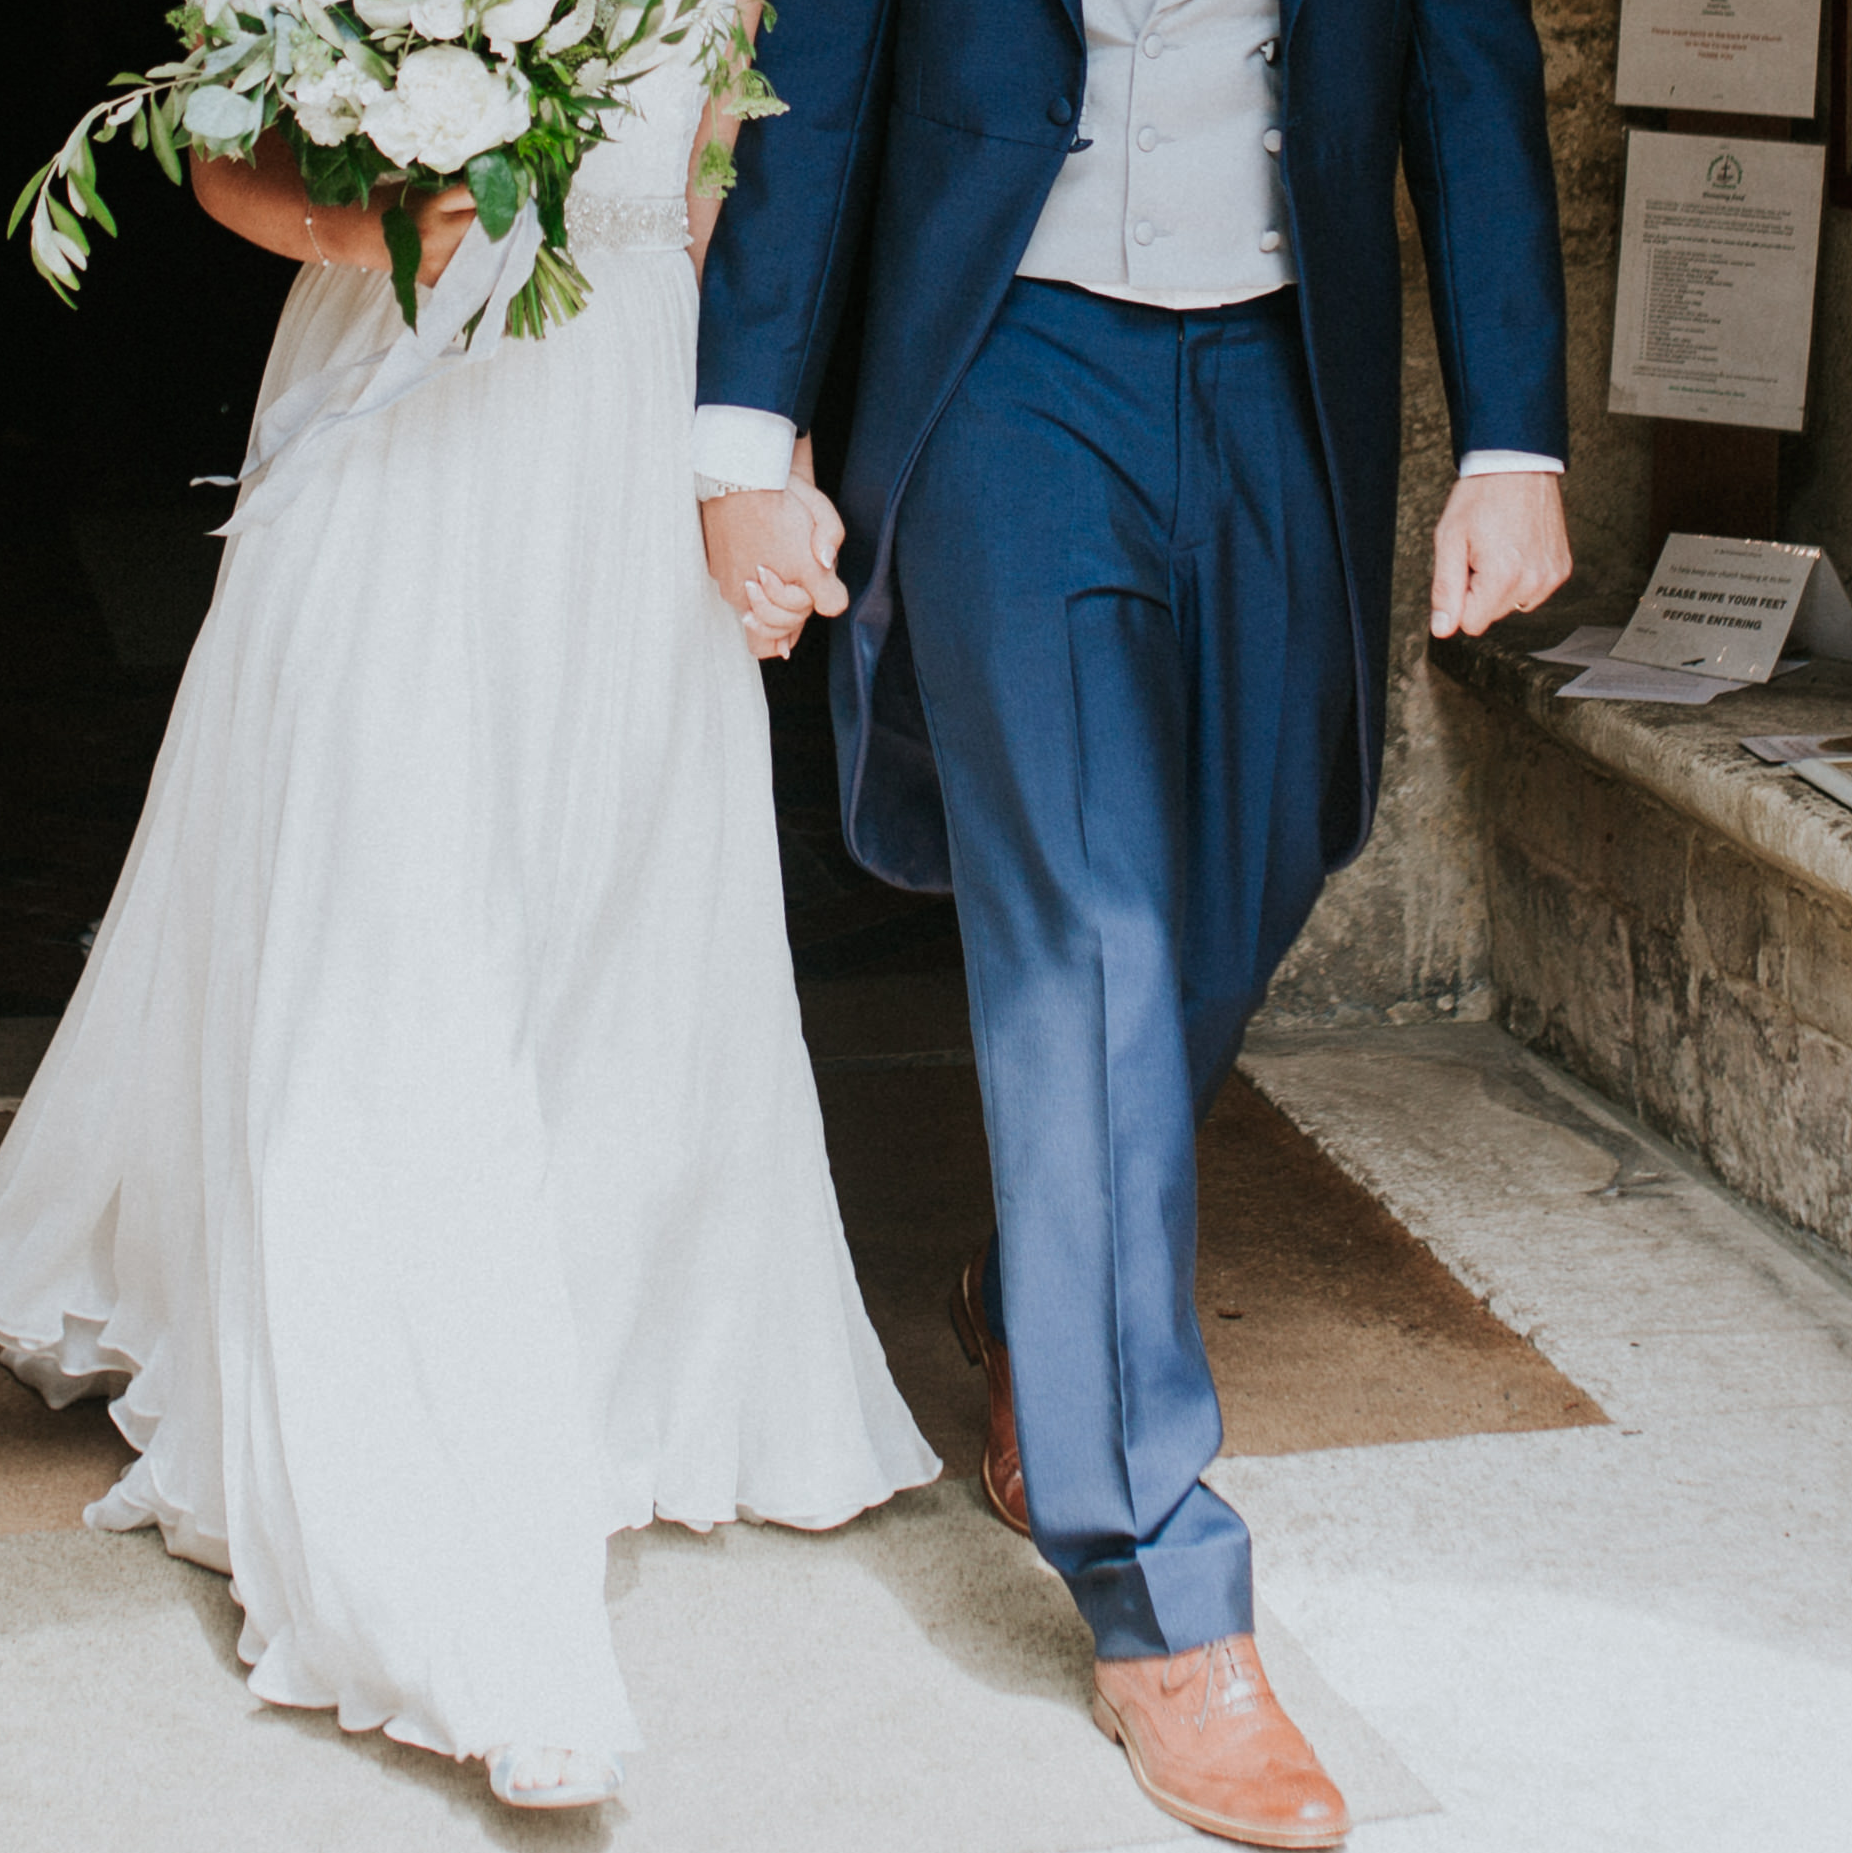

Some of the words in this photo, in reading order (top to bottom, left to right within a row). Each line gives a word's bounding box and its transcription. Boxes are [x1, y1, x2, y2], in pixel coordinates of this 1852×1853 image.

[1677, 565, 1691, 576] help
[1691, 567, 1706, 577] keep
[1706, 569, 1718, 577] our
[1718, 569, 1739, 579] church
[1739, 571, 1761, 584] looking
[1655, 585, 1697, 601] PLEASE
[1697, 590, 1724, 603] WIPE
[1728, 594, 1757, 608] YOUR
[1758, 597, 1787, 611] FEET
[1662, 609, 1704, 624] BEFORE
[1706, 613, 1762, 631] ENTERING
